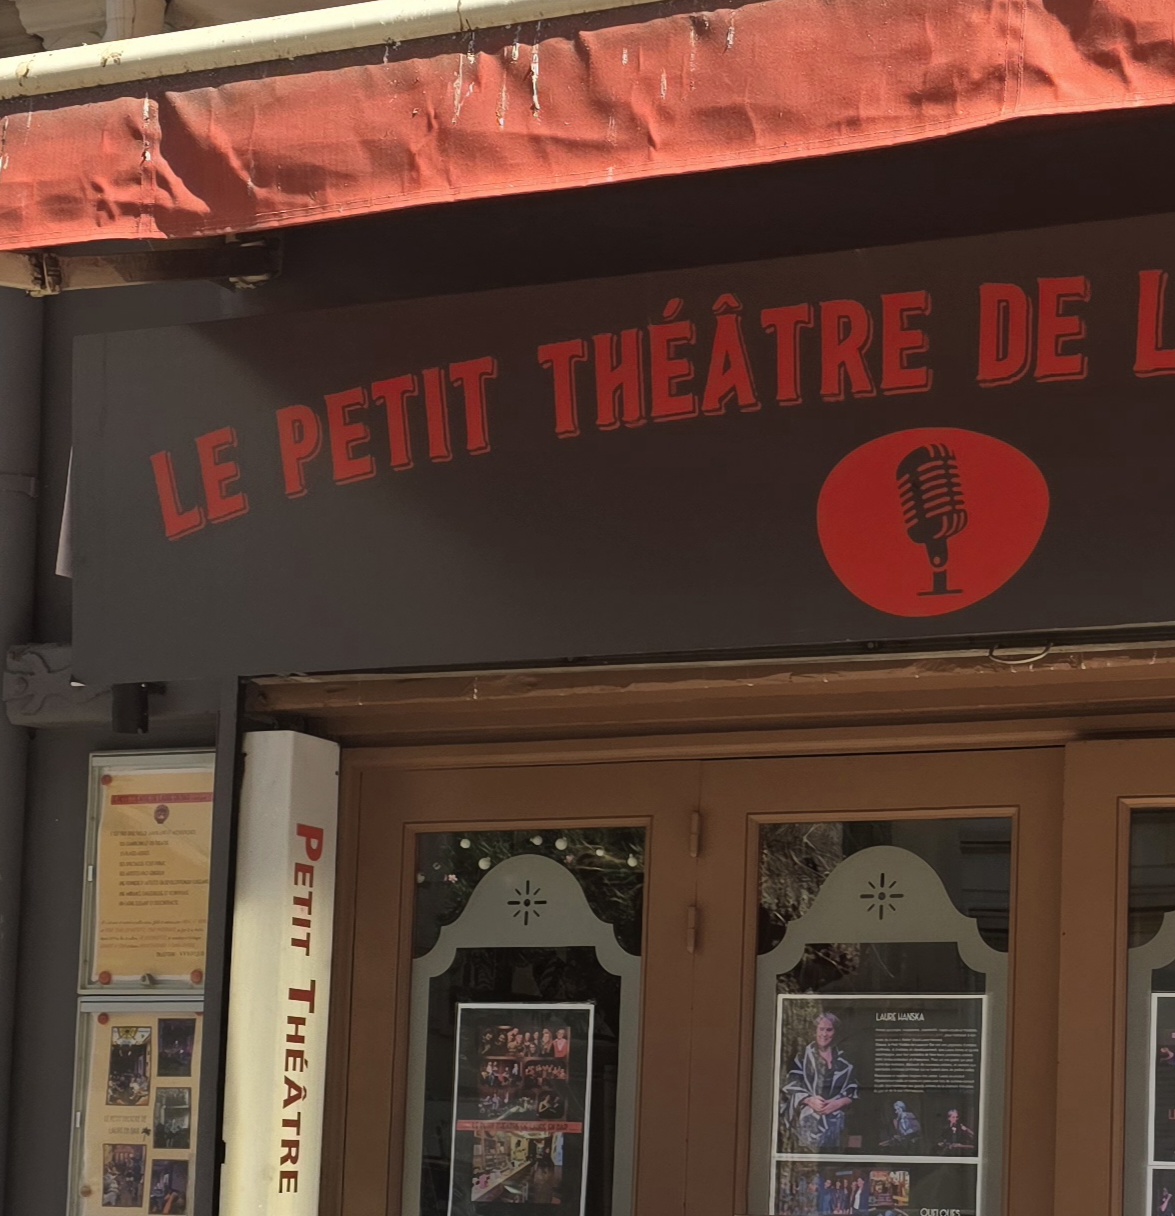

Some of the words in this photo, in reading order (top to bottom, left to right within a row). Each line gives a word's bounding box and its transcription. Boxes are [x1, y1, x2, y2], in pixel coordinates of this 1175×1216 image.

[150, 425, 247, 541] LE
[275, 354, 498, 498] PETIT
[537, 290, 932, 439] THÉÂTRE
[977, 275, 1092, 387] DE
[291, 823, 324, 956] PETIT
[278, 979, 316, 1194] THÉÂTRE
